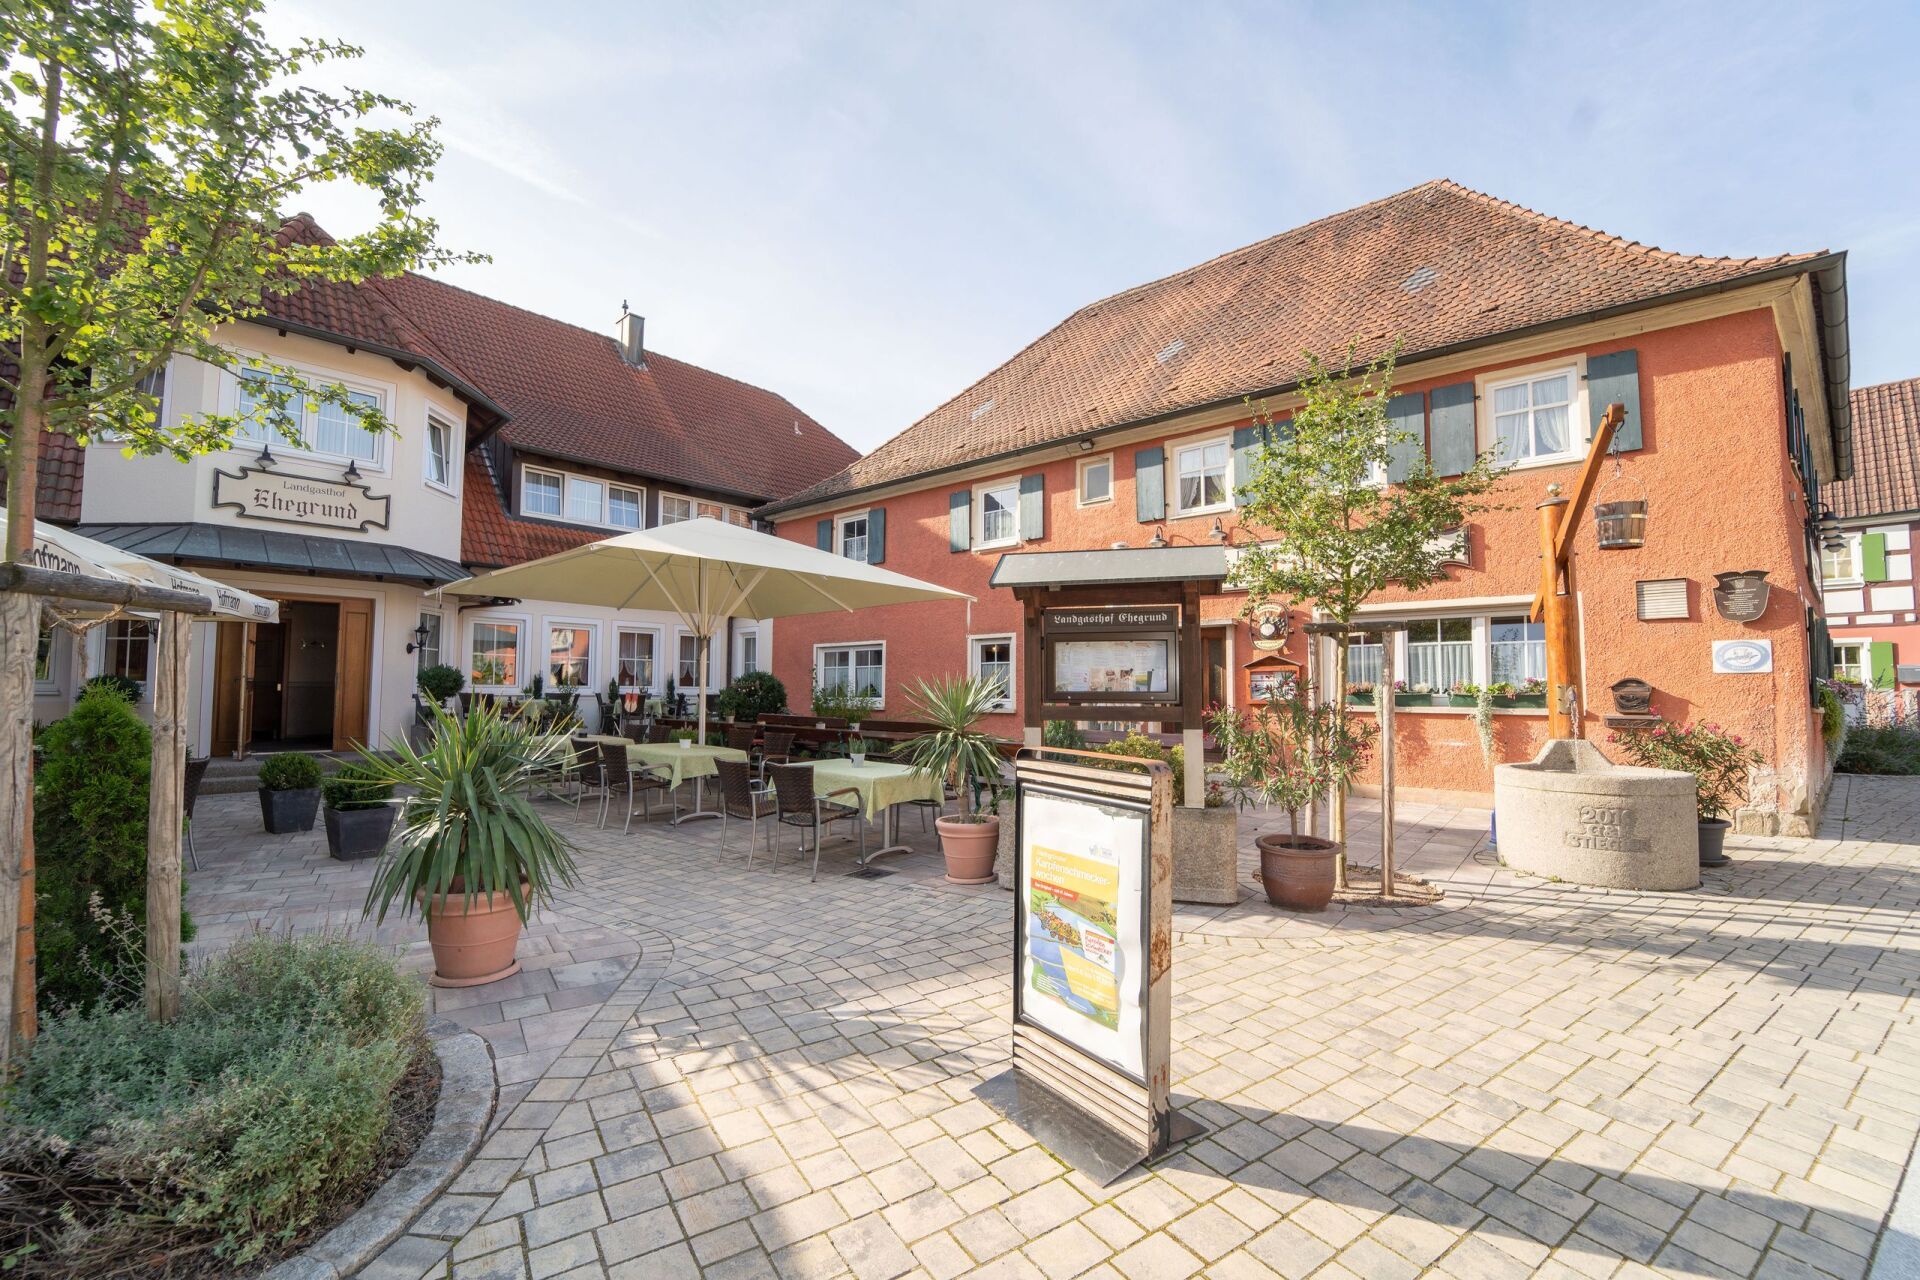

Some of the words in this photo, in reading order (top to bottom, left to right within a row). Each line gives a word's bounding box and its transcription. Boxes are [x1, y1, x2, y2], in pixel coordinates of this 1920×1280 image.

[283, 480, 346, 498] Landgasthof
[253, 487, 358, 520] Ehegrund
[33, 544, 81, 575] ofmann
[1053, 613, 1115, 626] Landgasthof
